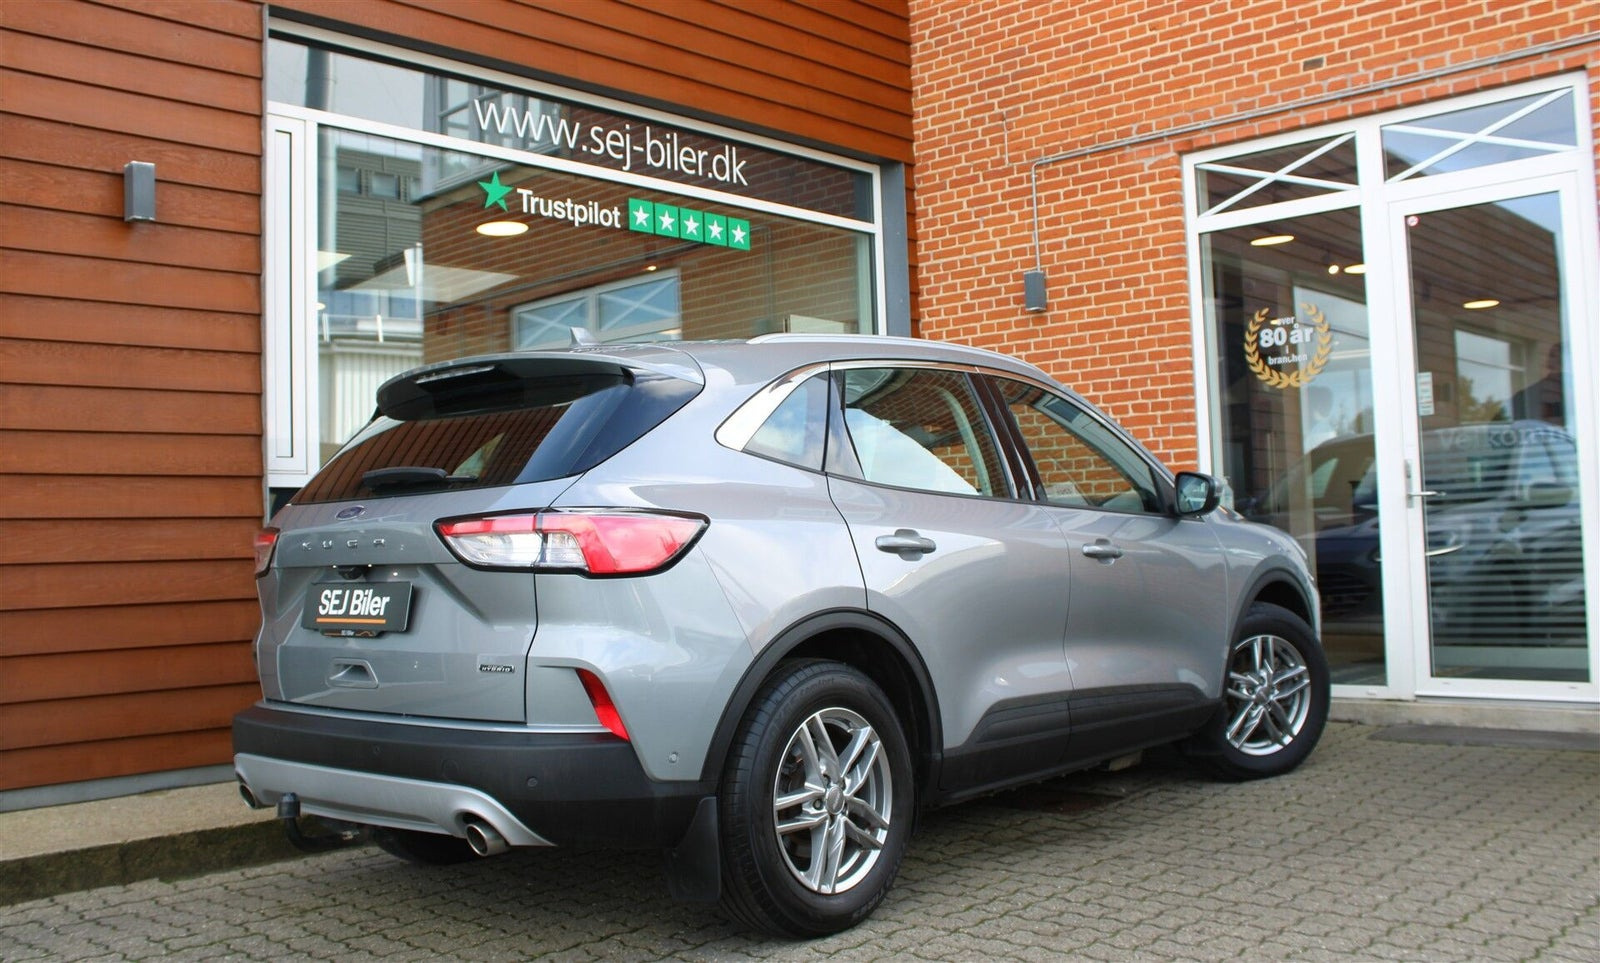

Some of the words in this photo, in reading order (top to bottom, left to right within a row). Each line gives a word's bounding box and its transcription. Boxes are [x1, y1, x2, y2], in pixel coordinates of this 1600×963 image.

[474, 99, 748, 186] www.sej-biler.dk
[516, 187, 621, 228] Trustpilot
[1260, 326, 1287, 348] 80
[1290, 322, 1314, 345] år
[302, 538, 385, 551] KUGA
[318, 589, 350, 615] SEJ
[349, 588, 391, 616] Biler
